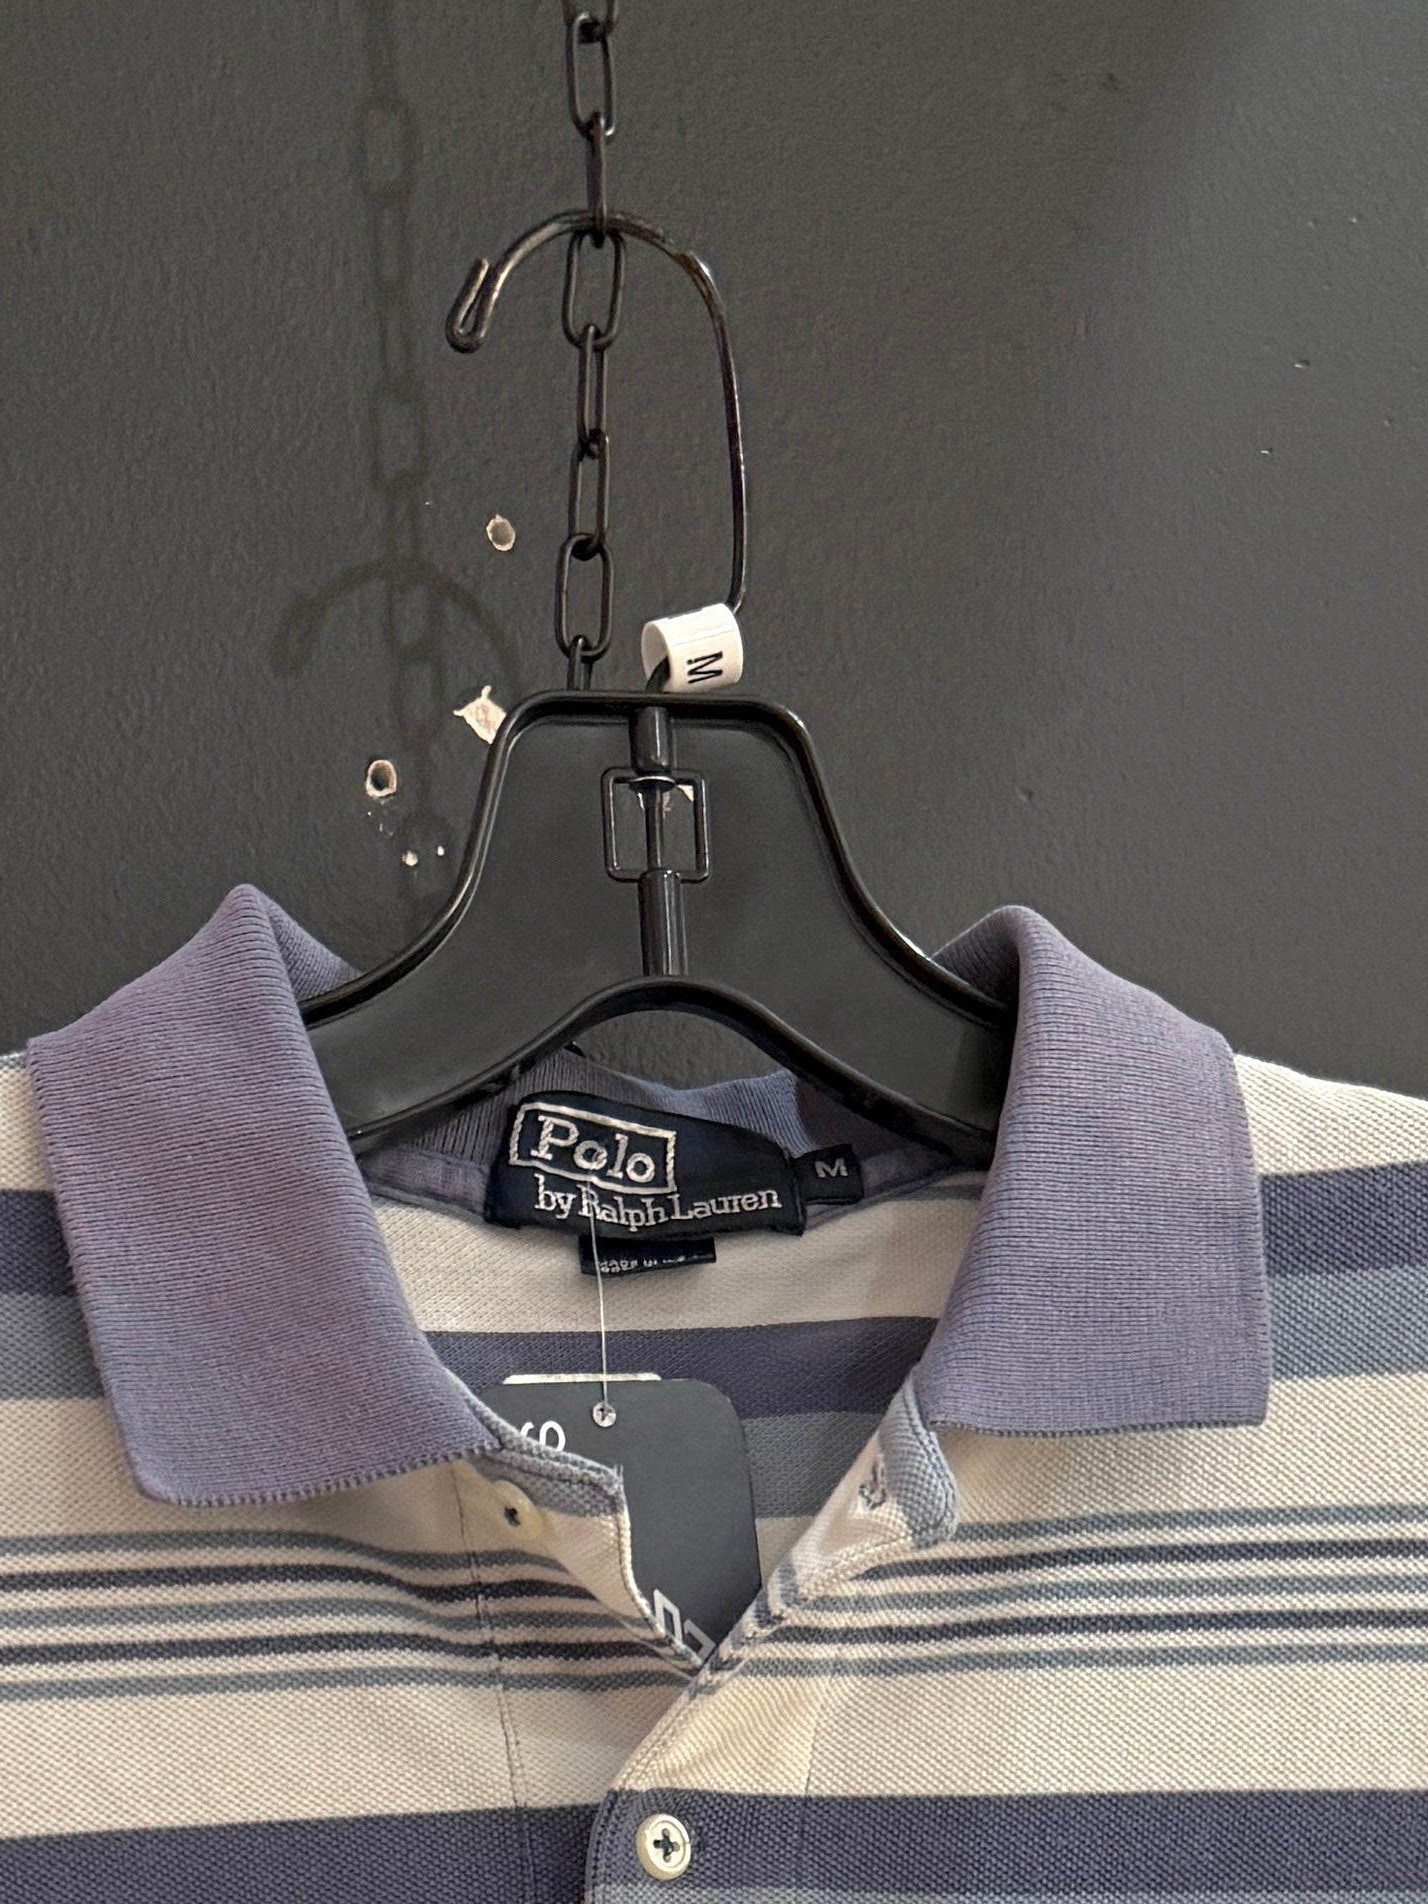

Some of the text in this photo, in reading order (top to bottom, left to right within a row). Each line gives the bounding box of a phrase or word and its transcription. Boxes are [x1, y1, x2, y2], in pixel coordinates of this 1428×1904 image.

[530, 1115, 655, 1183] Polo
[815, 1158, 848, 1178] M
[534, 1173, 782, 1232] by Ralph Lauren
